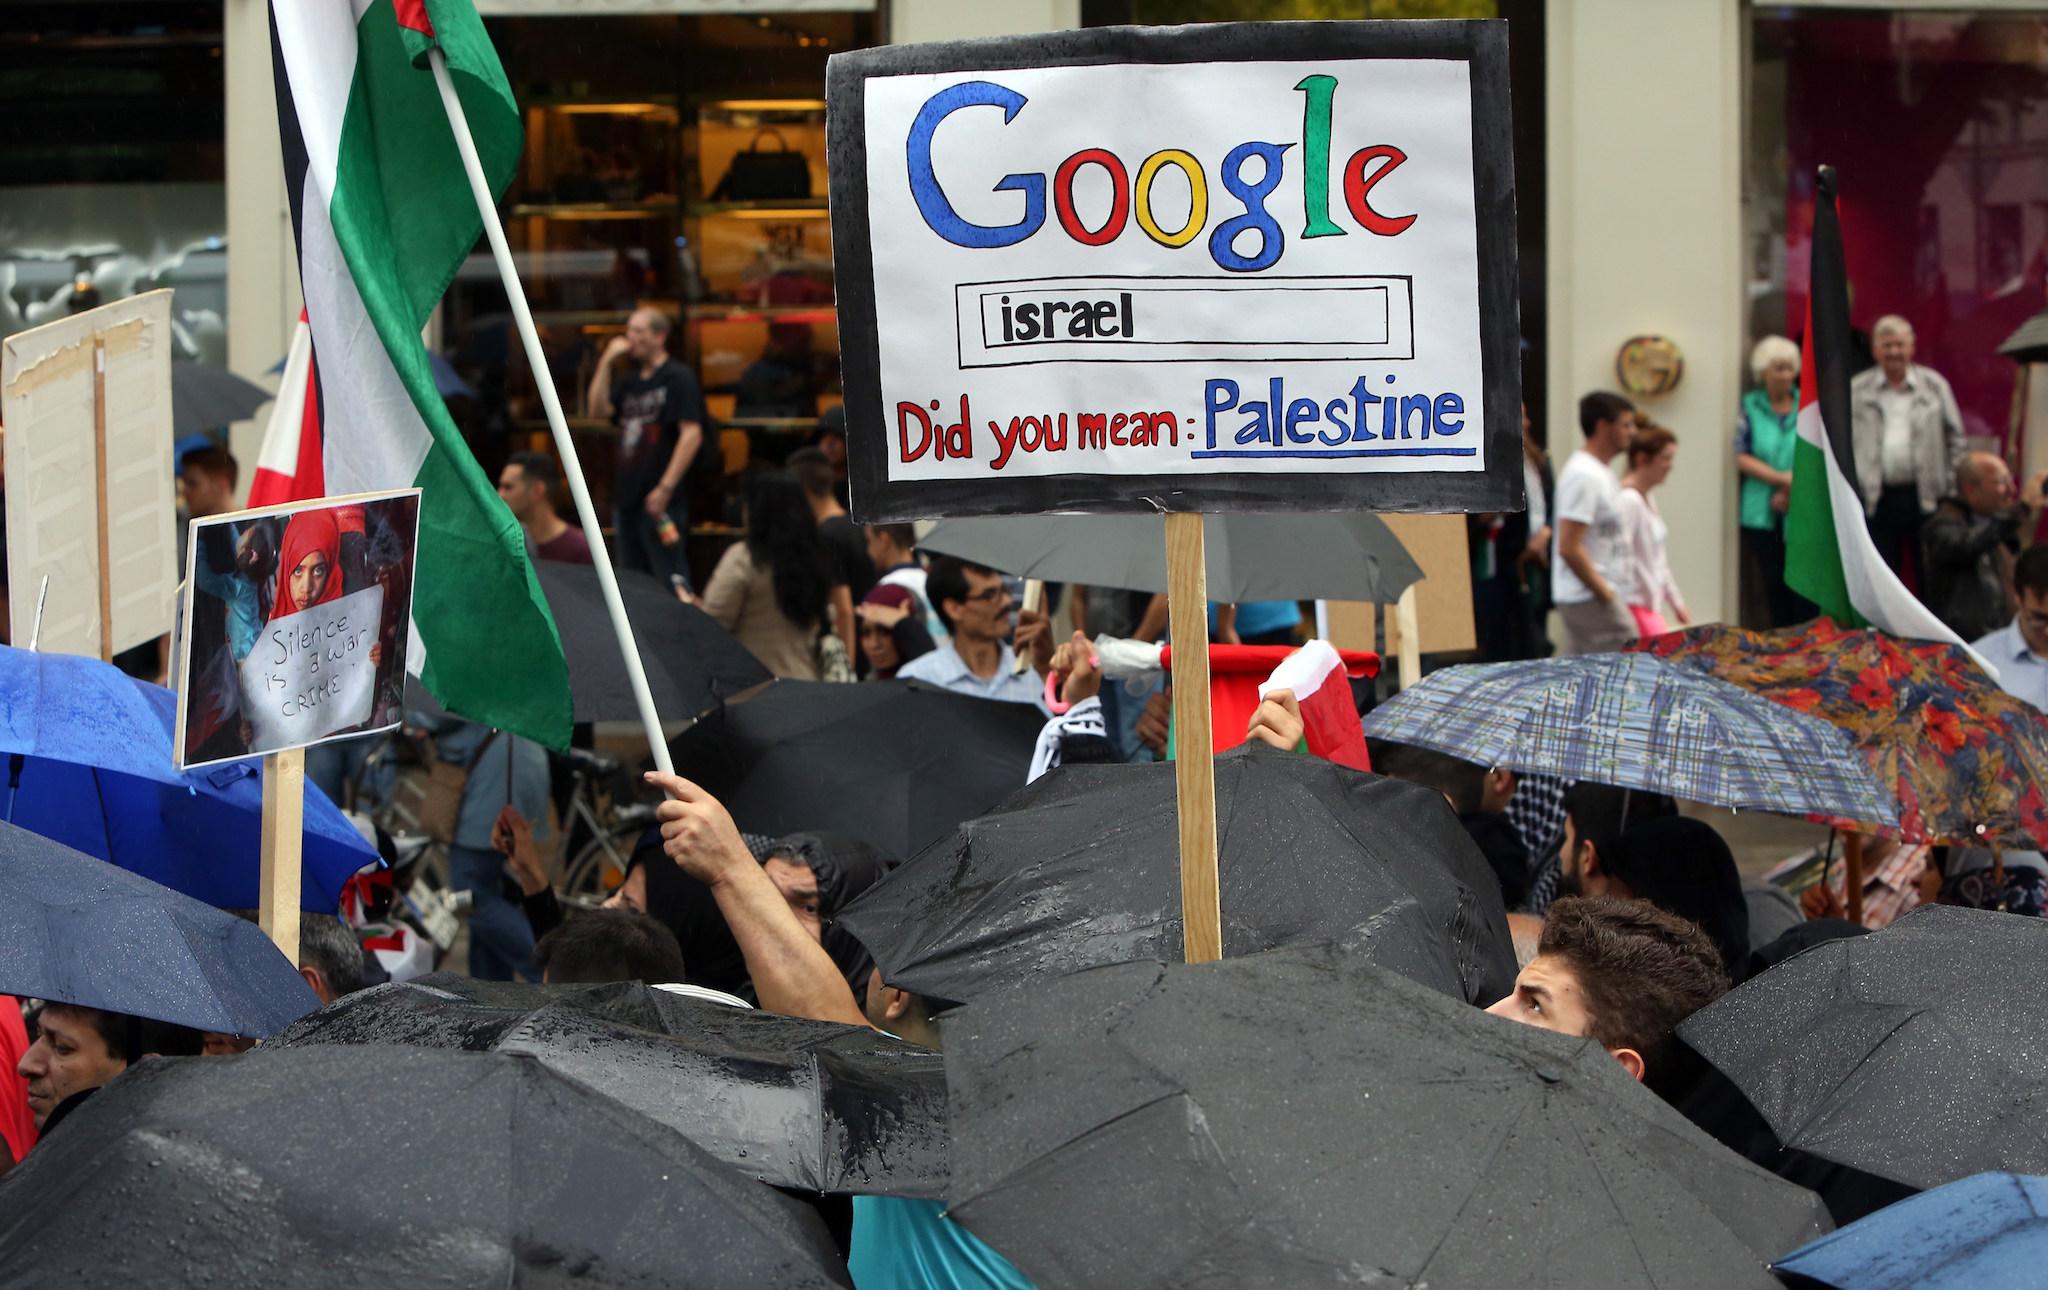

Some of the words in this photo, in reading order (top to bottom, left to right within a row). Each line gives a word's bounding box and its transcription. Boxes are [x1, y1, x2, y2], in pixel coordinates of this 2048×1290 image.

[906, 74, 1418, 272] Google
[1001, 293, 1134, 342] israel
[897, 394, 972, 463] Did
[989, 412, 1068, 470] you
[1204, 375, 1465, 449] Palestine
[264, 673, 287, 691] is
[310, 652, 321, 674] a
[327, 629, 367, 662] war
[272, 616, 350, 665] Silence
[281, 675, 342, 717] CRIME
